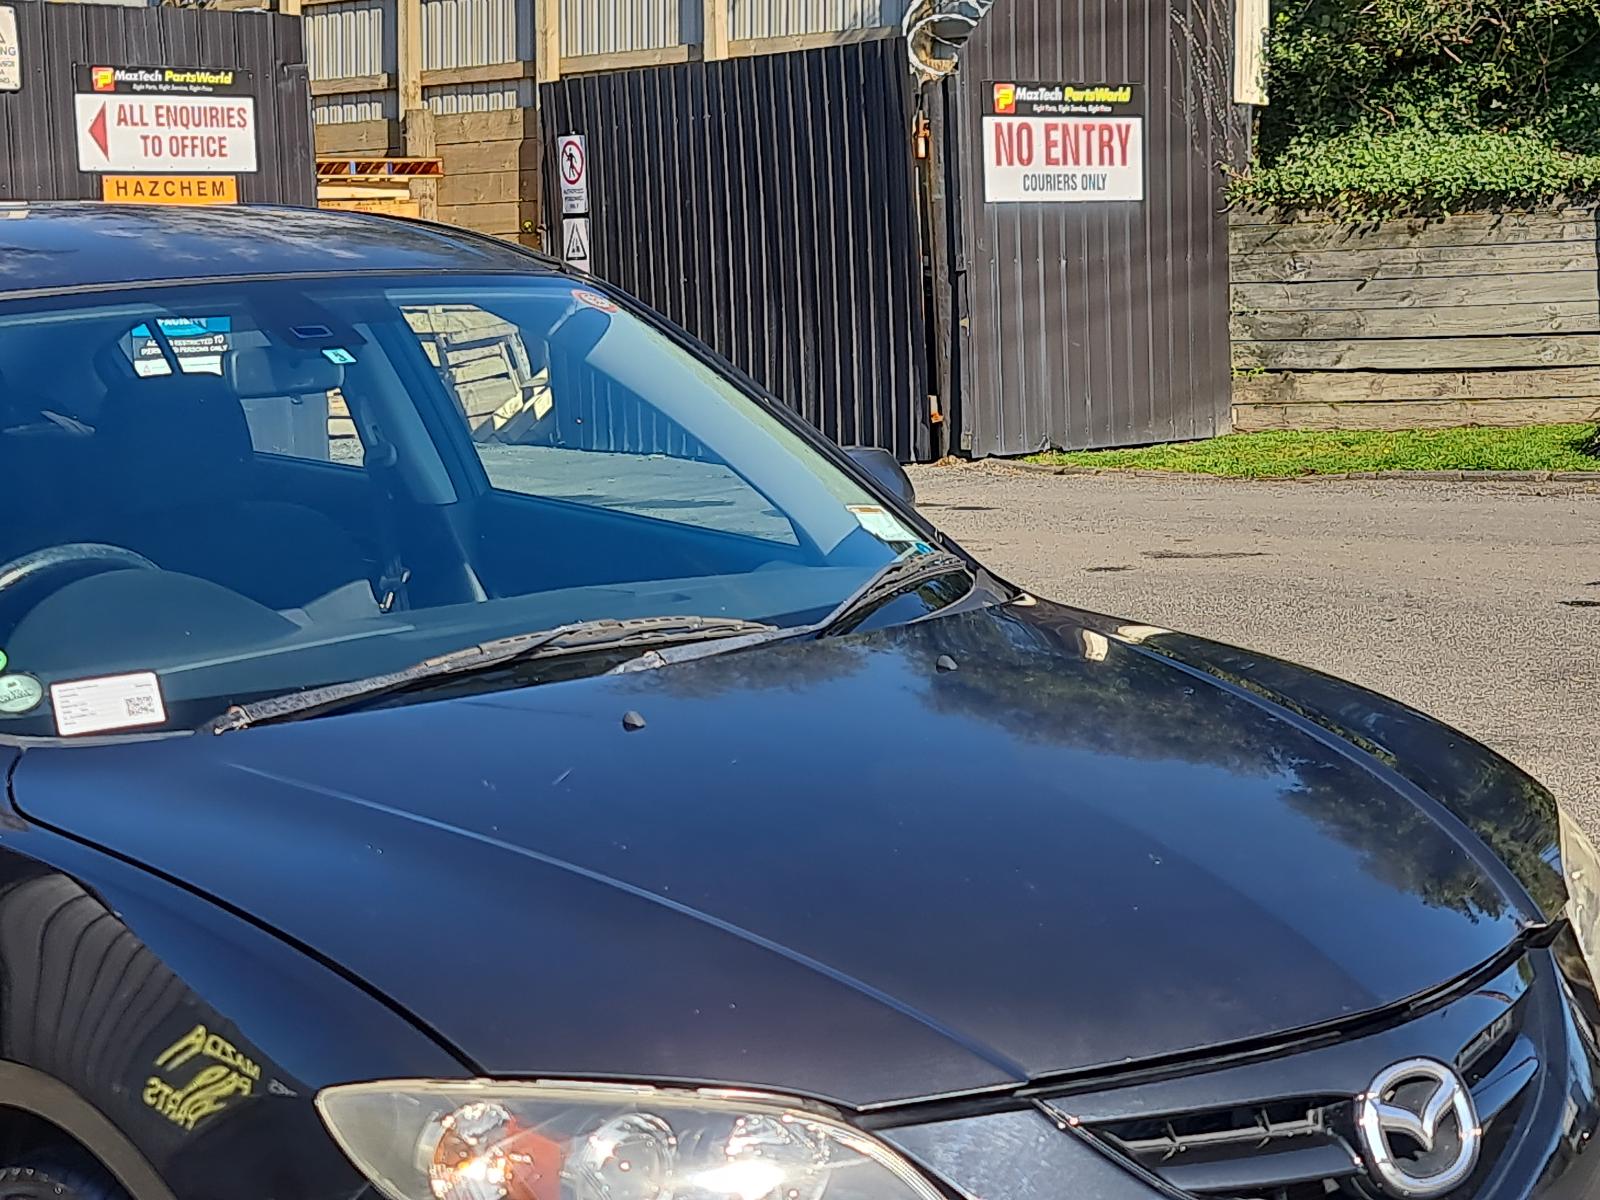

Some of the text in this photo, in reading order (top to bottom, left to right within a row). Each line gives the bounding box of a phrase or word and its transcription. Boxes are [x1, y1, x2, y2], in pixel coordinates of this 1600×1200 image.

[165, 71, 232, 84] PartsWorld
[1064, 86, 1131, 102] PartsWorld
[117, 103, 247, 129] ALL ENQUIRIES
[140, 135, 228, 158] TO OFFICE
[994, 122, 1132, 166] NO ENTRY
[116, 180, 226, 197] HAZCHEM
[1023, 174, 1107, 191] COURIERS ONLY
[213, 335, 224, 344] TO
